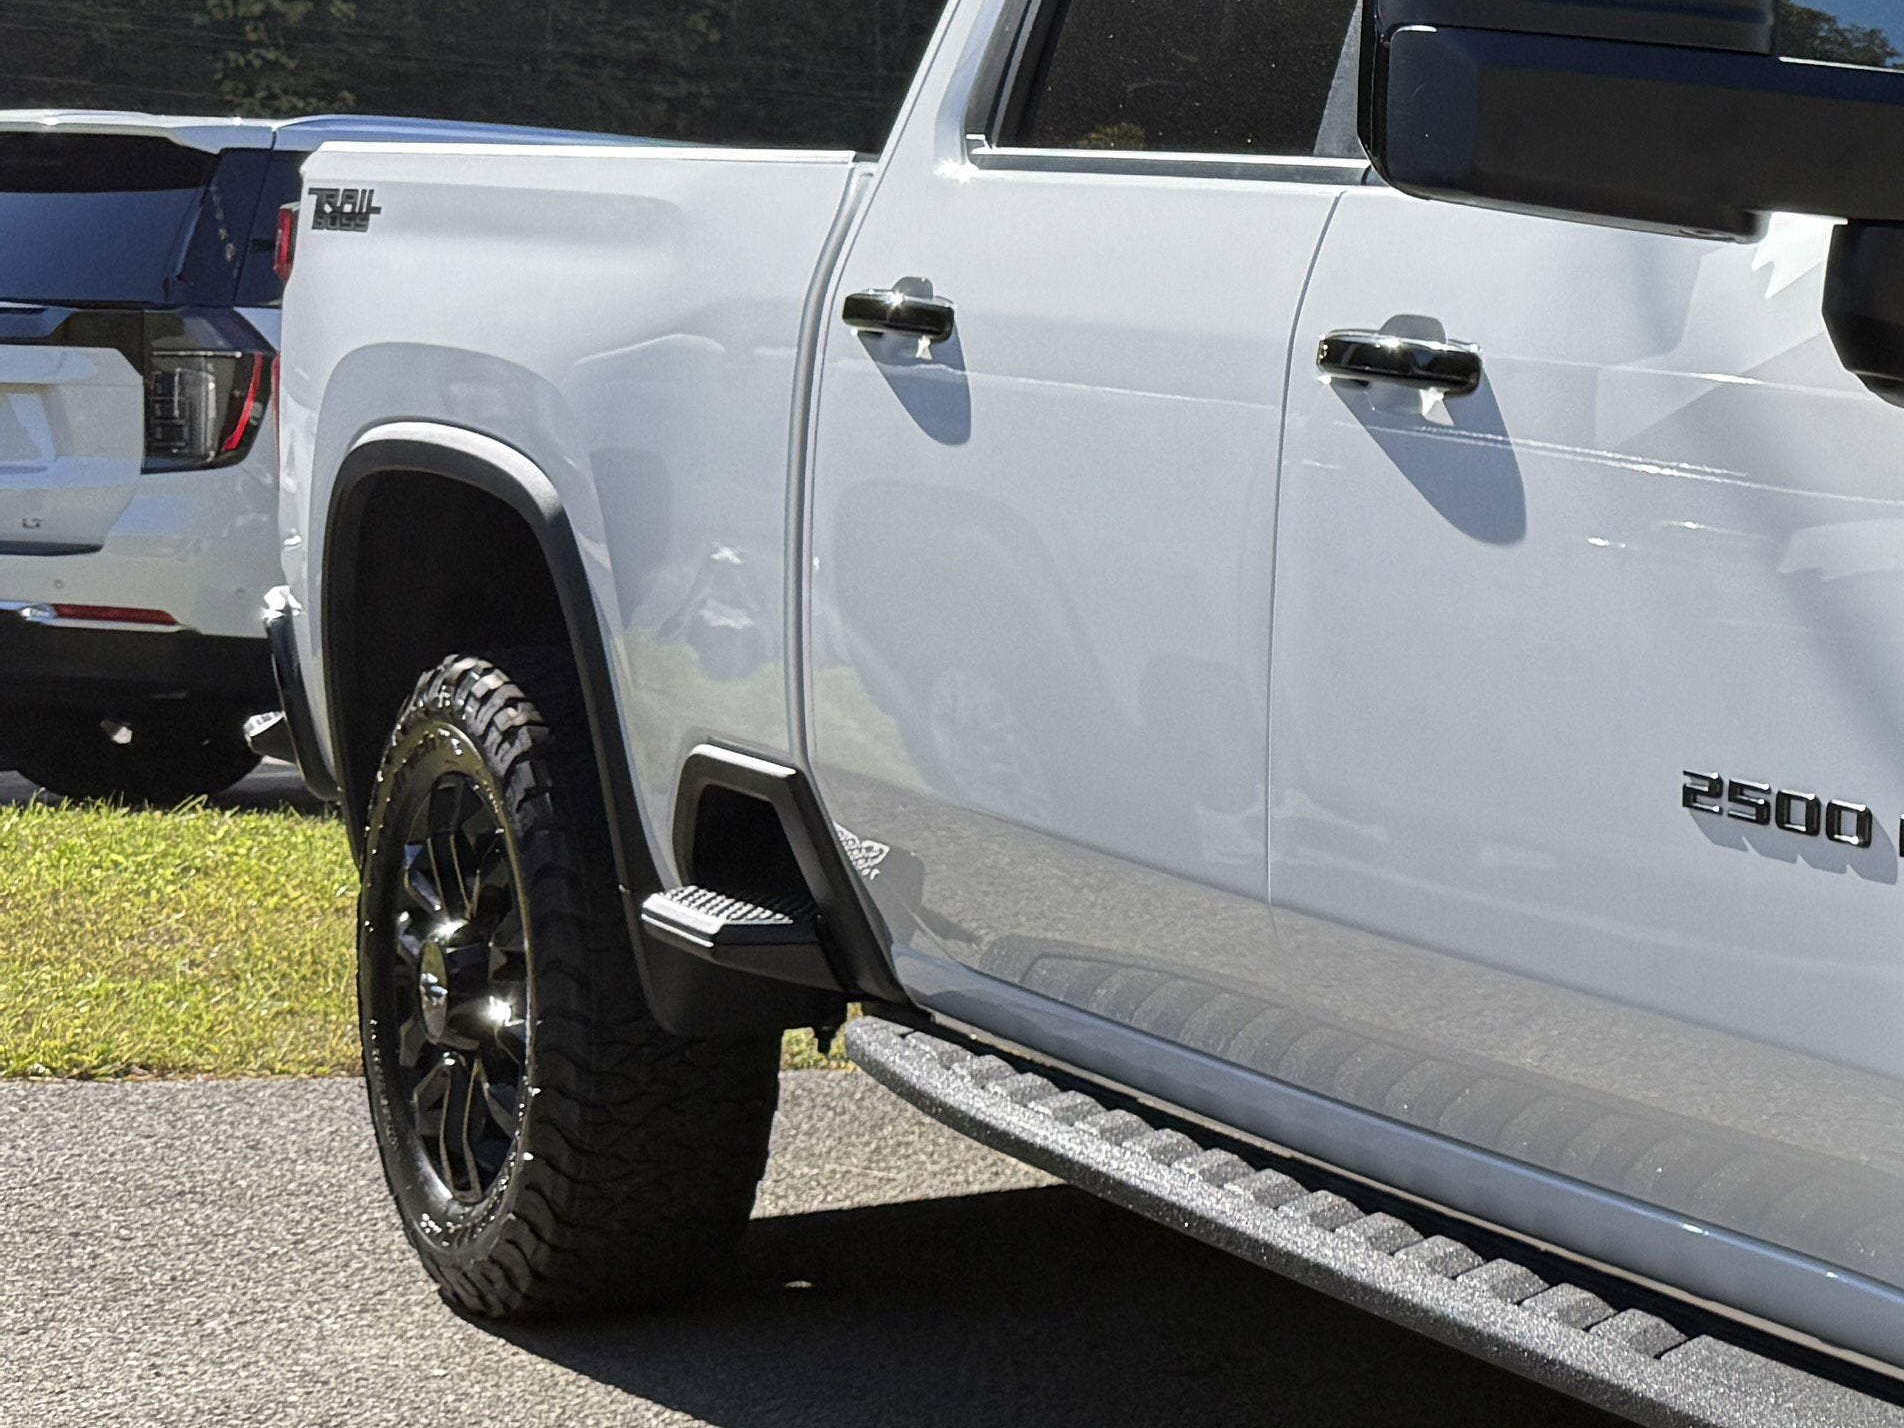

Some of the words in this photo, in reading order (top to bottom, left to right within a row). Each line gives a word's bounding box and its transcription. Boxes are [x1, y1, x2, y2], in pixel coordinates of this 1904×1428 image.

[308, 187, 382, 214] TRAIL
[311, 212, 370, 233] BOSS
[1681, 769, 1873, 849] 2500
